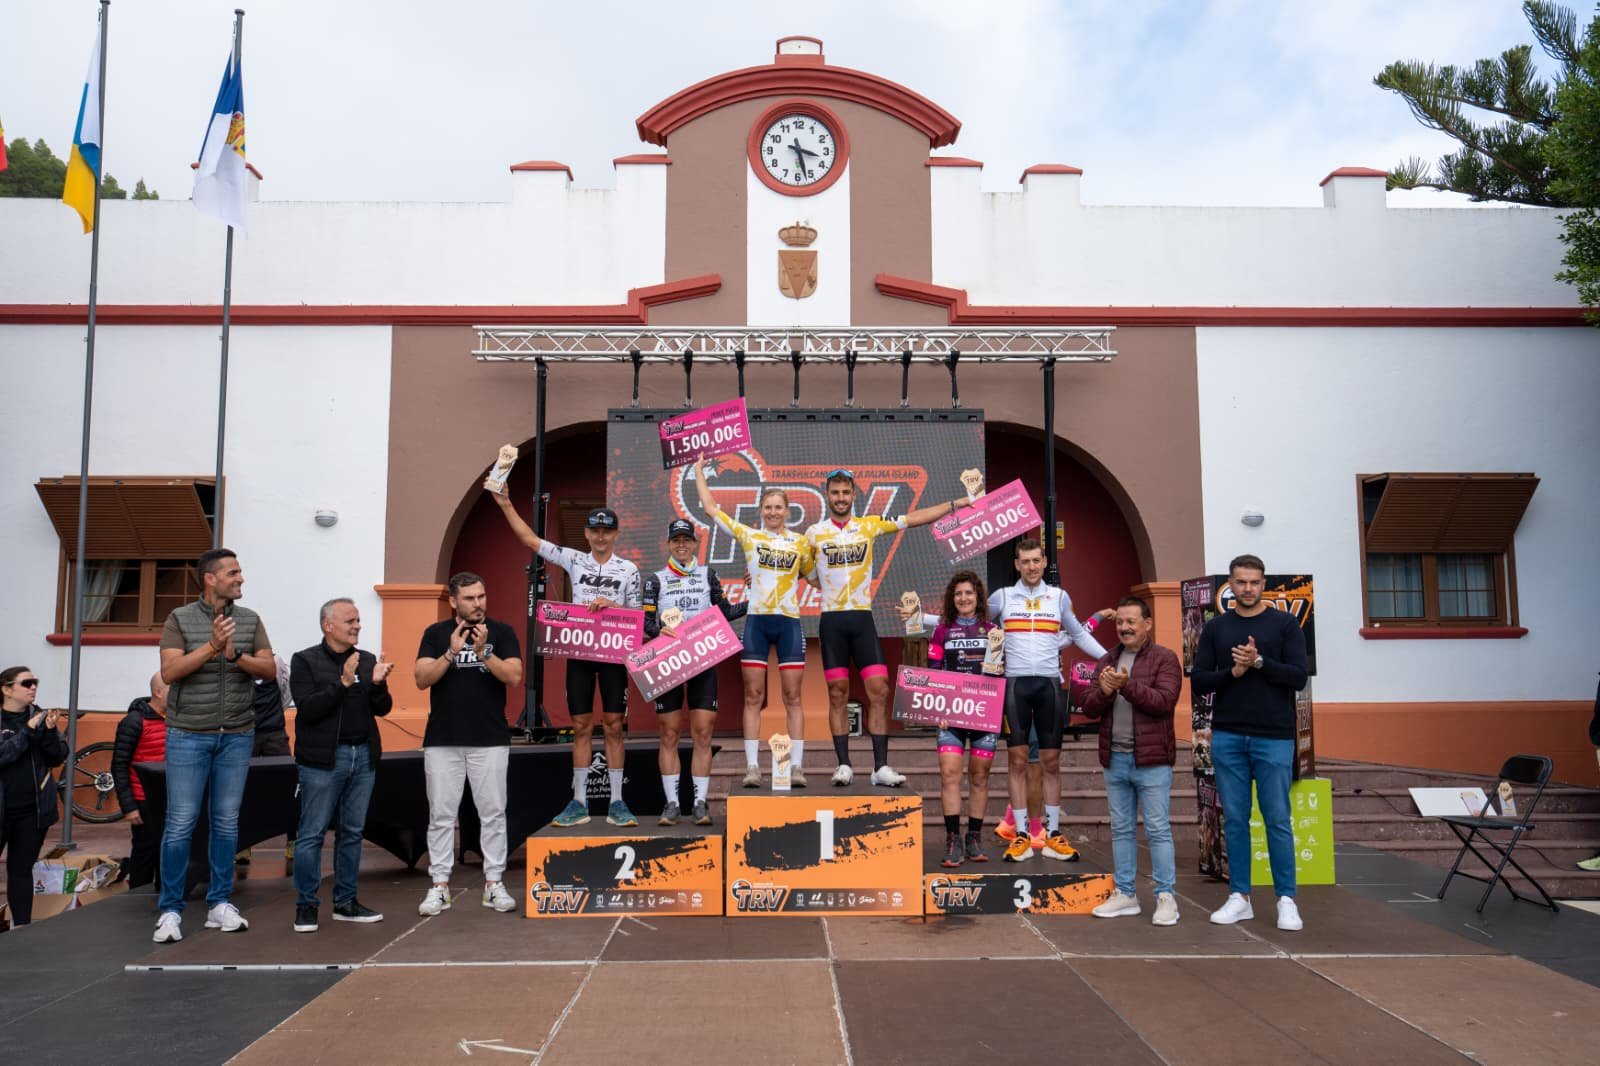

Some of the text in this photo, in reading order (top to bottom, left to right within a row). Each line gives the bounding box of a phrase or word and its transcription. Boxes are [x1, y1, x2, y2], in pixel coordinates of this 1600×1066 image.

[780, 124, 790, 133] 11
[792, 120, 805, 129] 12
[809, 126, 815, 134] 1
[770, 134, 781, 144] 10
[818, 134, 826, 143] 2
[766, 146, 774, 155] 9
[823, 147, 830, 156] 3
[771, 159, 778, 168] 8
[818, 160, 825, 169] 4
[782, 168, 789, 177] 7
[794, 173, 801, 182] 6
[807, 169, 814, 178] 5
[669, 422, 744, 456] 1.500,00€
[948, 502, 1030, 553] 1.500,00€
[758, 546, 797, 569] TRV
[825, 543, 868, 566] TRV
[579, 573, 622, 590] KTM
[545, 625, 635, 651] 1.000,00€
[951, 640, 980, 648] TARO
[459, 650, 478, 663] TR
[643, 628, 730, 685] 1.000,00€
[911, 691, 987, 718] 500,00€
[815, 810, 834, 860] 1
[614, 845, 636, 880] 2
[535, 890, 583, 911] TRV
[735, 888, 784, 910] TRV
[935, 887, 982, 907] TRV
[1013, 878, 1032, 909] 3
